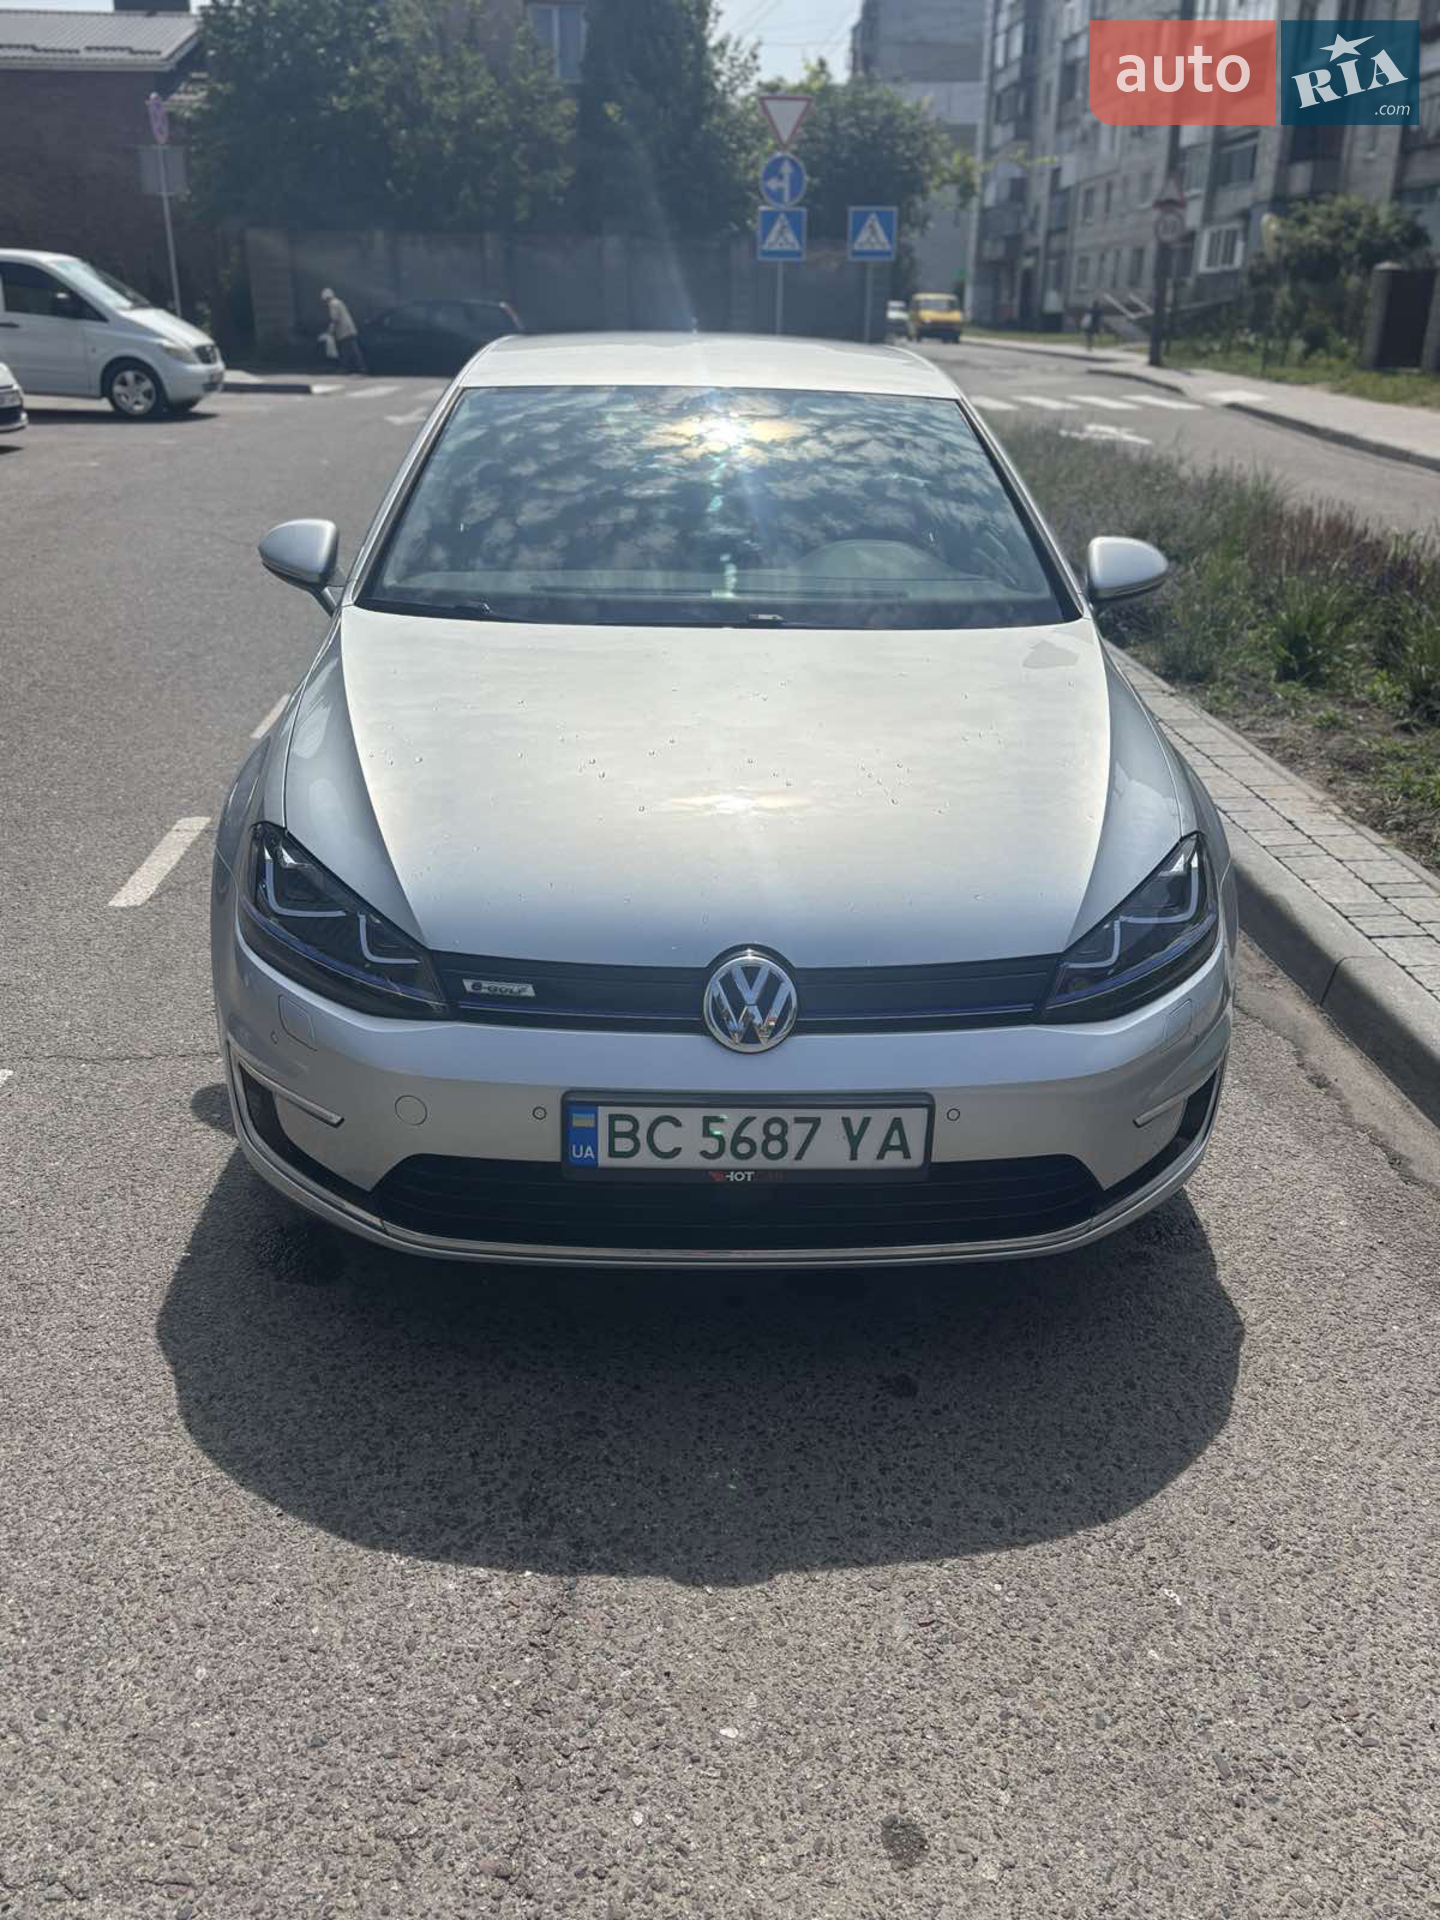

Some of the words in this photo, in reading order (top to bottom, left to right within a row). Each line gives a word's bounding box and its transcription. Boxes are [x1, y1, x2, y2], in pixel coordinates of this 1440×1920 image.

[571, 1144, 595, 1159] UA
[607, 1113, 682, 1159] BC
[699, 1115, 822, 1161] 5687
[841, 1116, 912, 1161] YA
